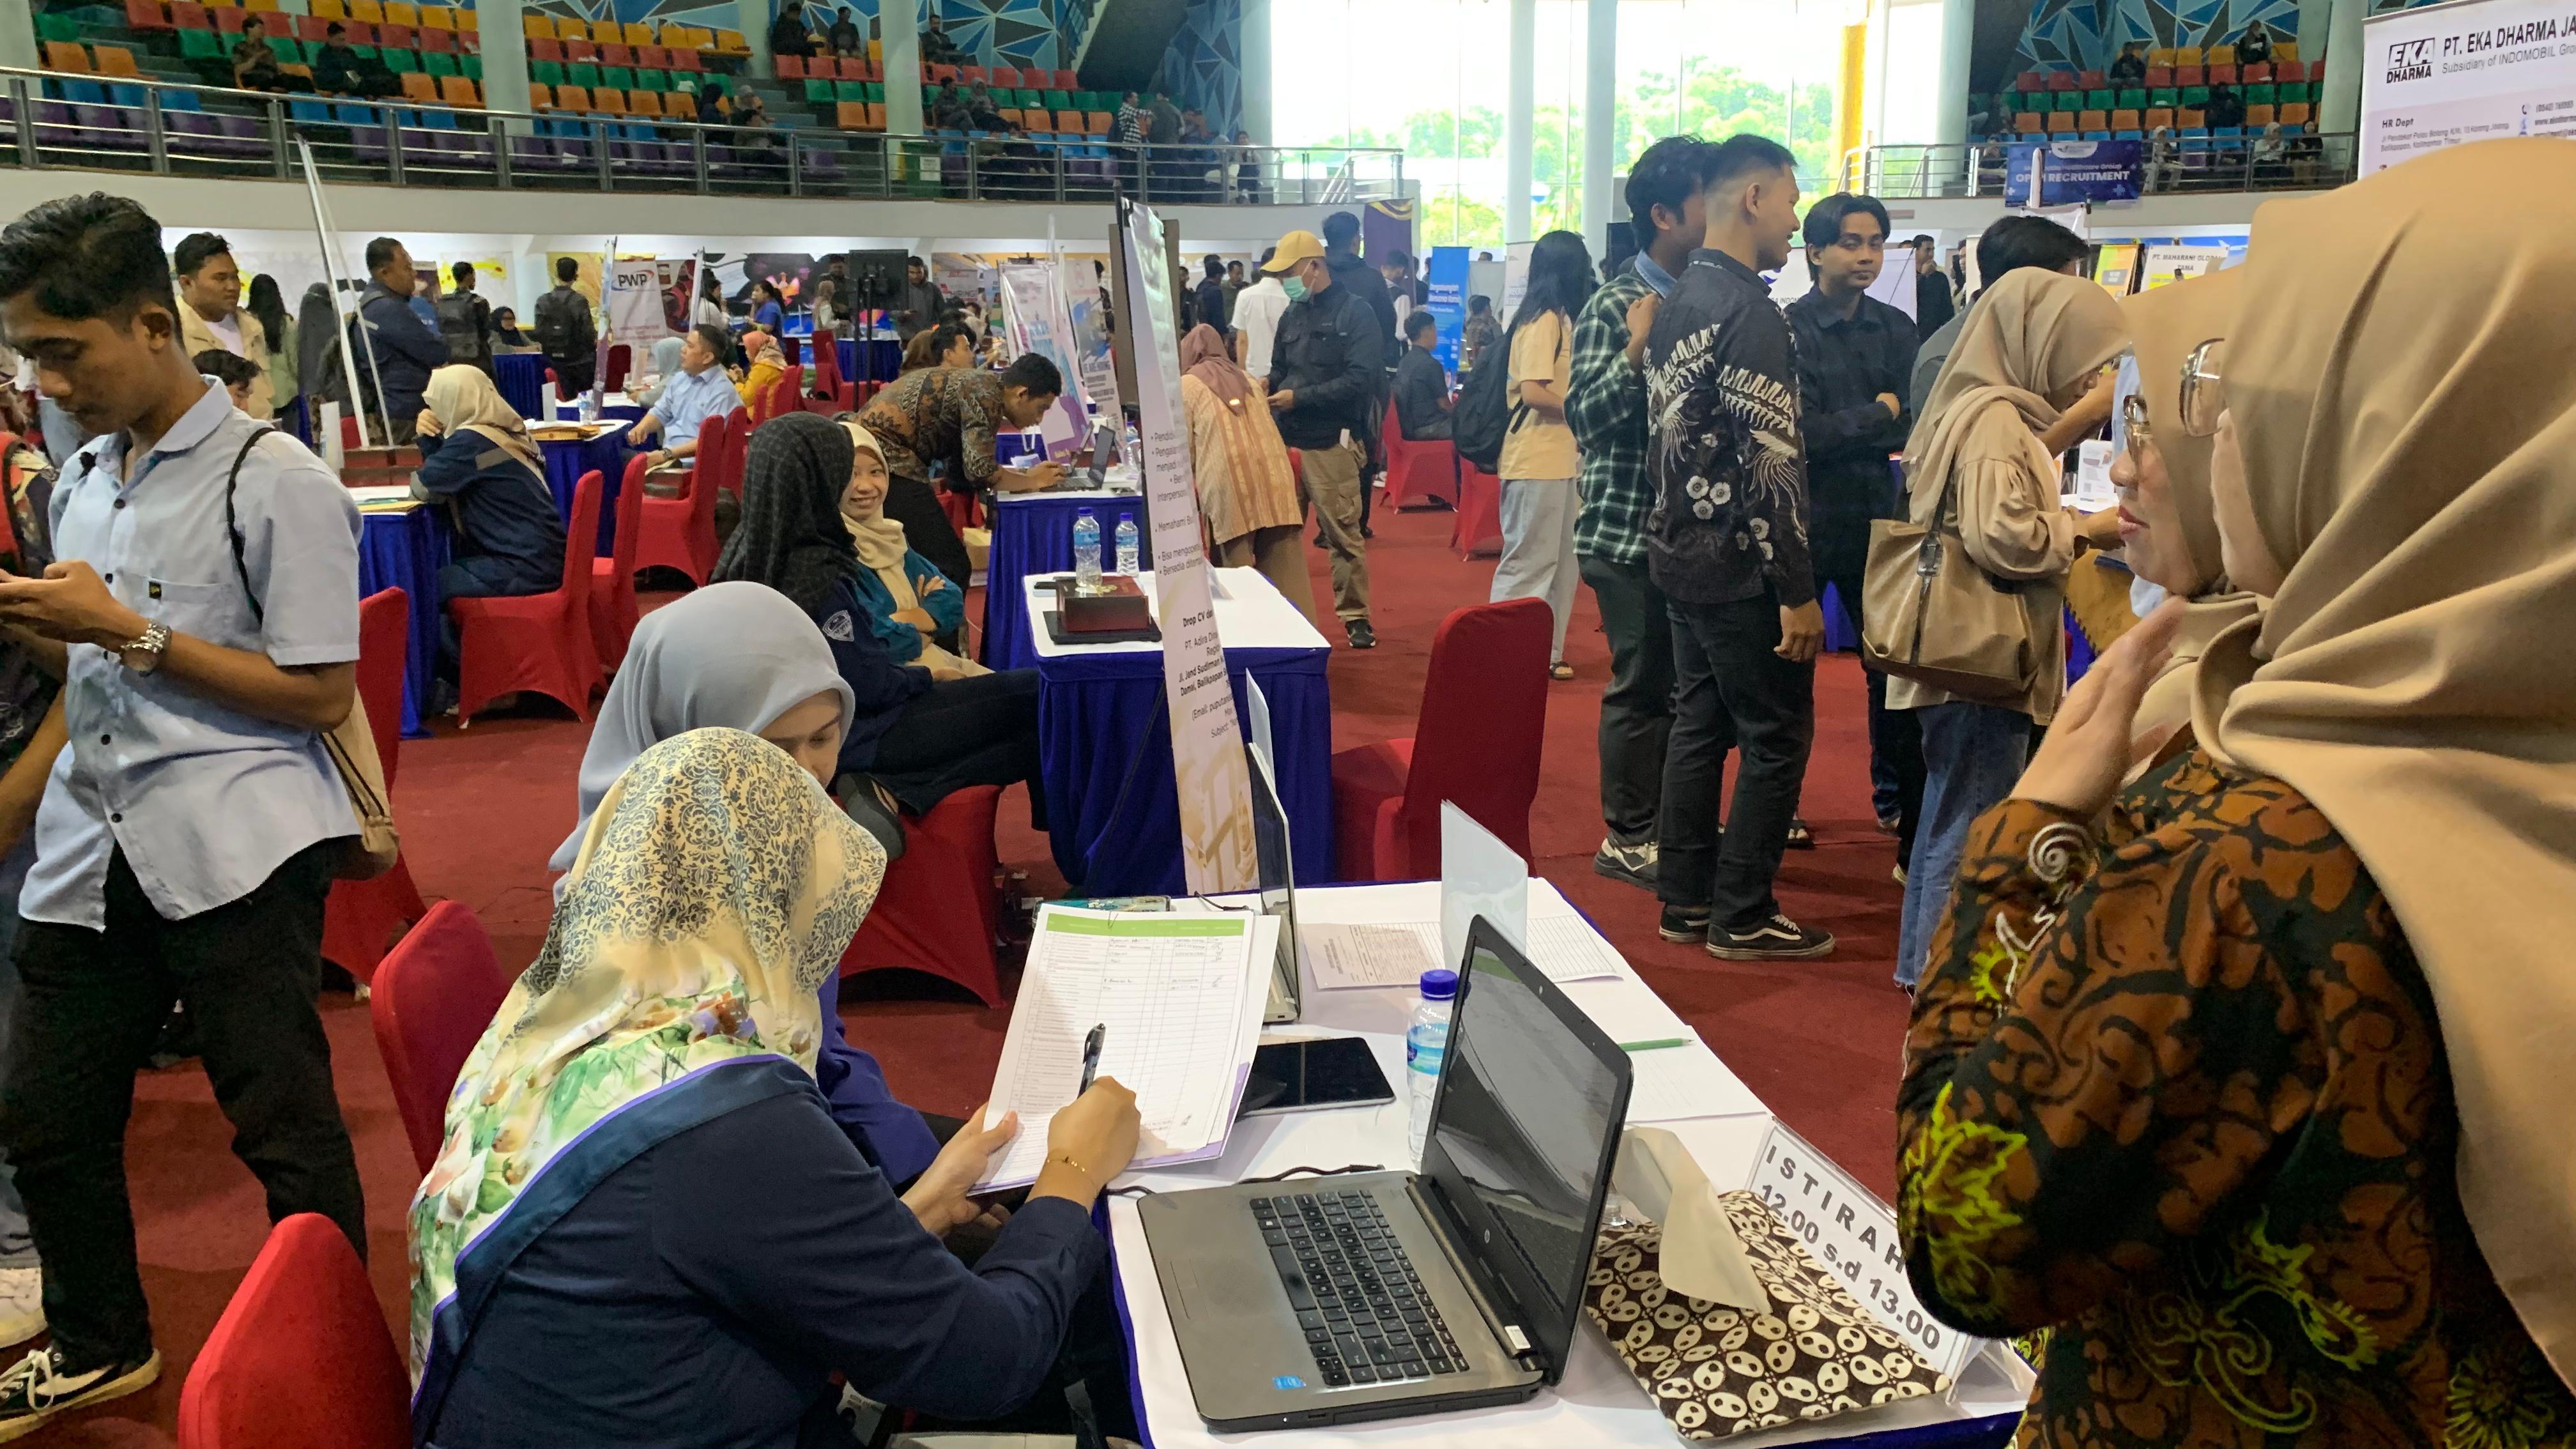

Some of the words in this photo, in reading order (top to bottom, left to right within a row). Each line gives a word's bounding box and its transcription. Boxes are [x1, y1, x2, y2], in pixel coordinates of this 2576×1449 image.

[2443, 36, 2462, 57] PT.
[2467, 30, 2492, 53] EKA
[2496, 18, 2556, 49] DHARMA
[2389, 38, 2435, 69] EKA
[2442, 58, 2485, 74] Subsidiary
[2487, 54, 2497, 66] of
[2499, 45, 2556, 65] INDOMOBIL
[2386, 65, 2432, 84] DHARMA
[2382, 119, 2393, 128] HR
[2395, 118, 2414, 128] Dept
[2016, 172, 2046, 183] OP
[2048, 171, 2130, 183] RECRUITMENT
[617, 273, 647, 287] PWP
[1183, 616, 1197, 627] Drop
[1197, 611, 1205, 622] CV
[1185, 666, 1197, 680] Jend
[1197, 658, 1220, 674] Sudirman
[1197, 671, 1223, 689] Balikpapan
[1761, 1184, 1820, 1245] 12.00
[1823, 1243, 1862, 1284] s.d
[1869, 1278, 1940, 1351] 13.00
